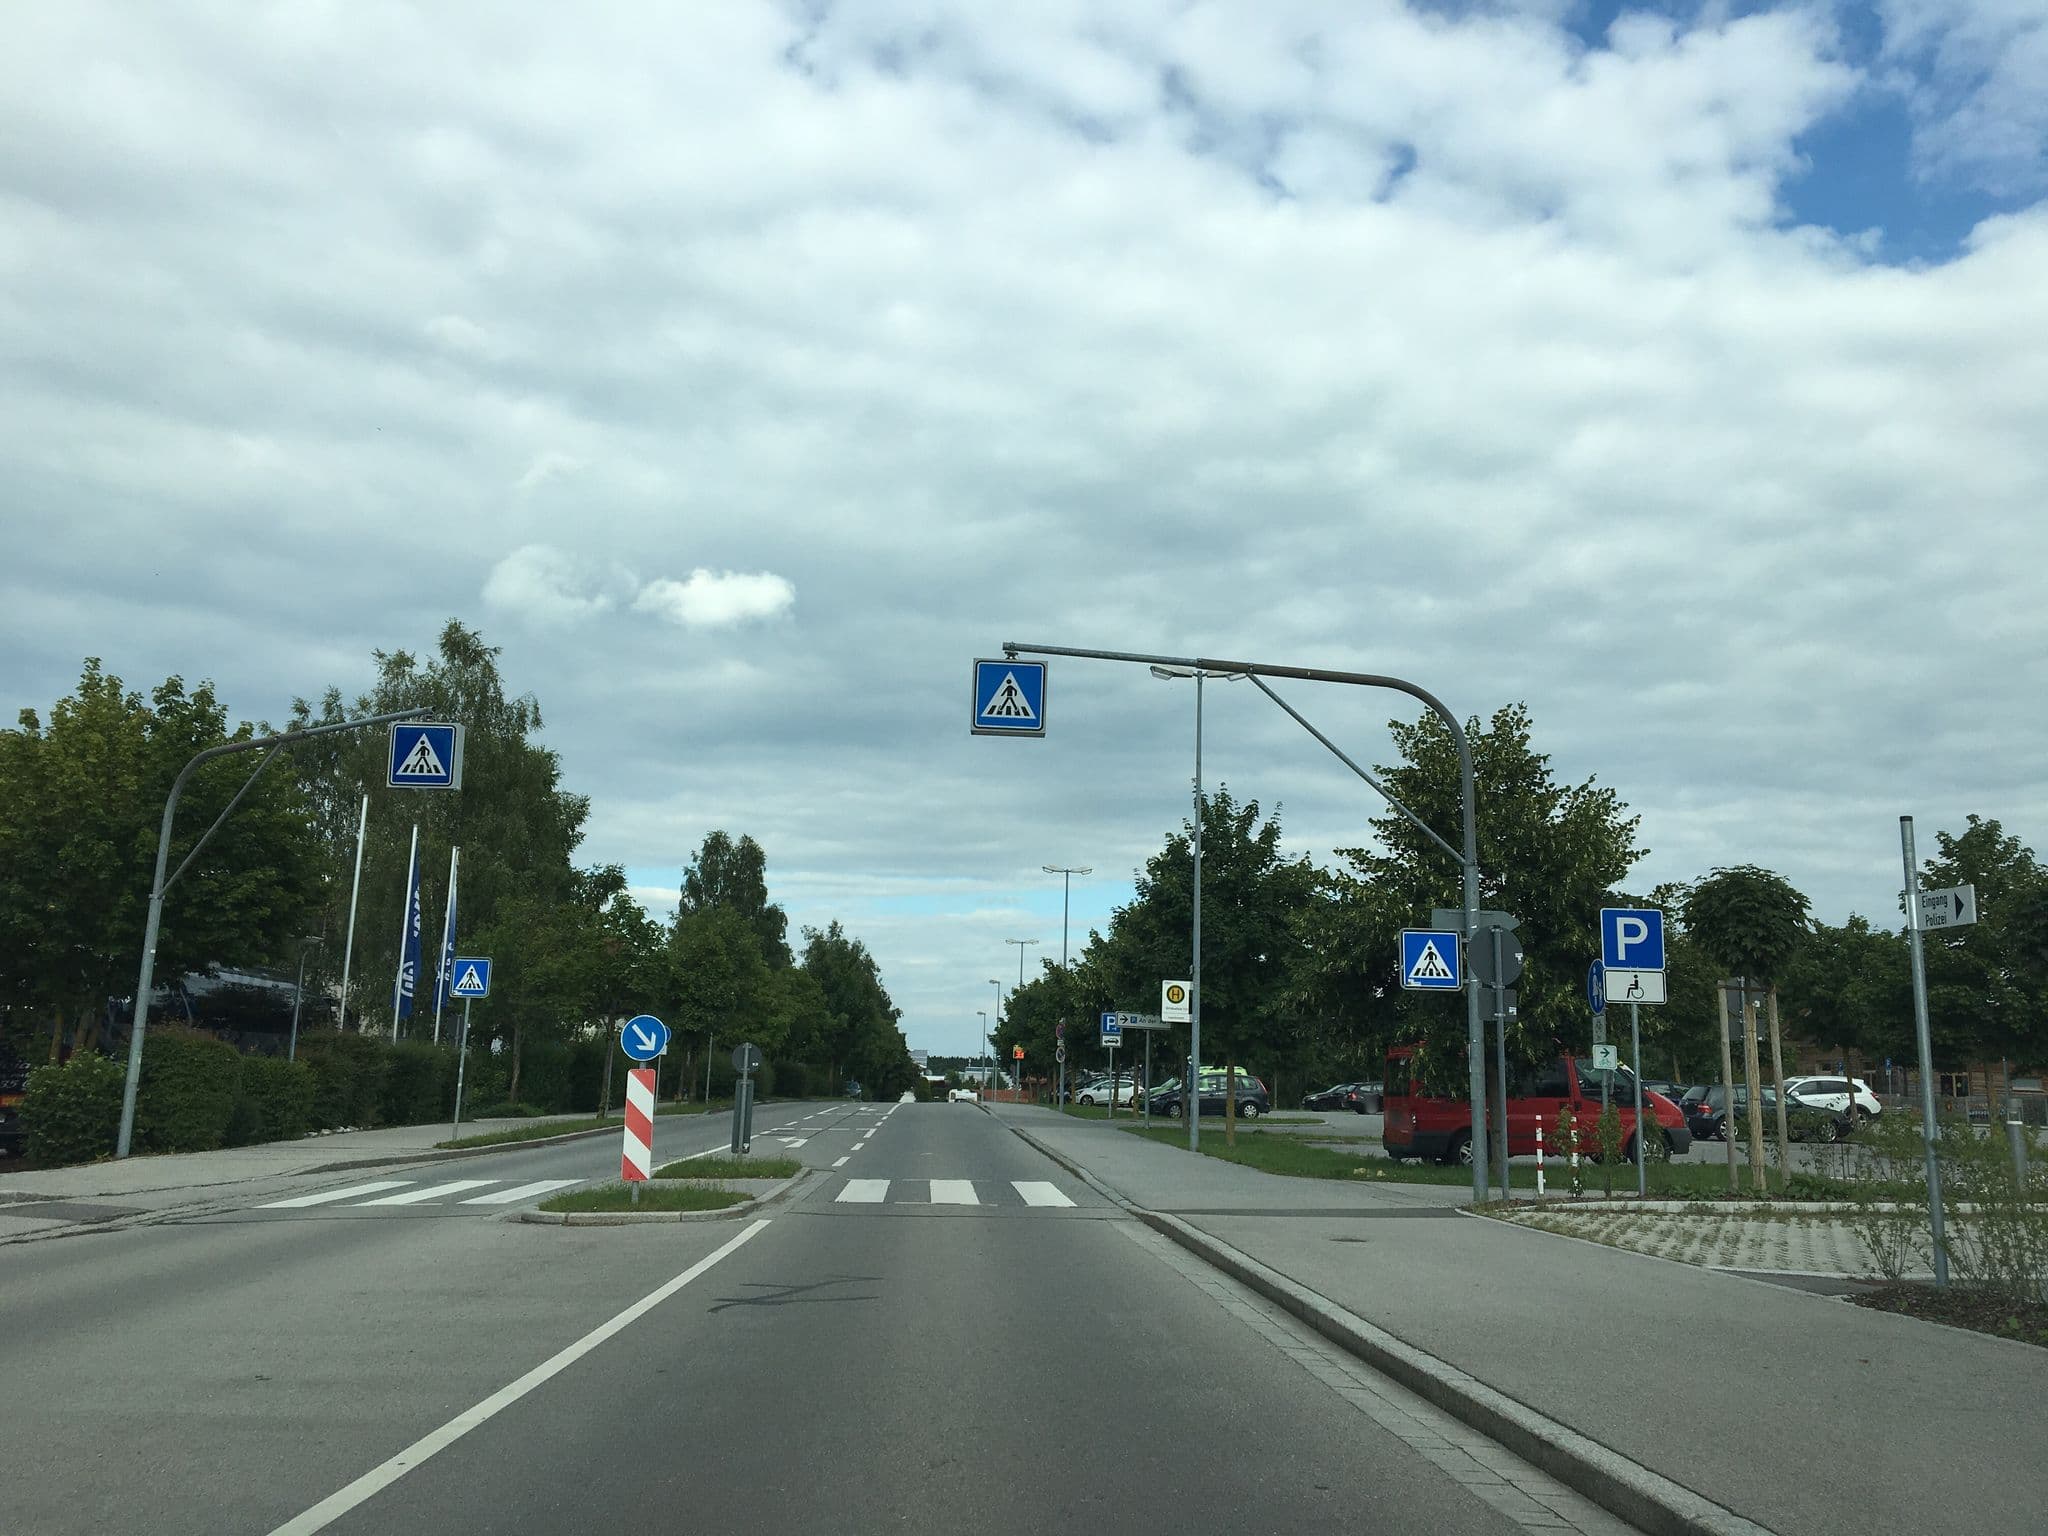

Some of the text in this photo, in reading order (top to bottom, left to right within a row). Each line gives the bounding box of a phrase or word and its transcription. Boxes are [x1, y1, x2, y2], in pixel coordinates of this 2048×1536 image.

[1922, 895, 1948, 909] Eingang
[1926, 911, 1947, 927] Polizei
[1616, 917, 1649, 960] P
[1172, 989, 1180, 1000] H
[1106, 1016, 1116, 1031] P
